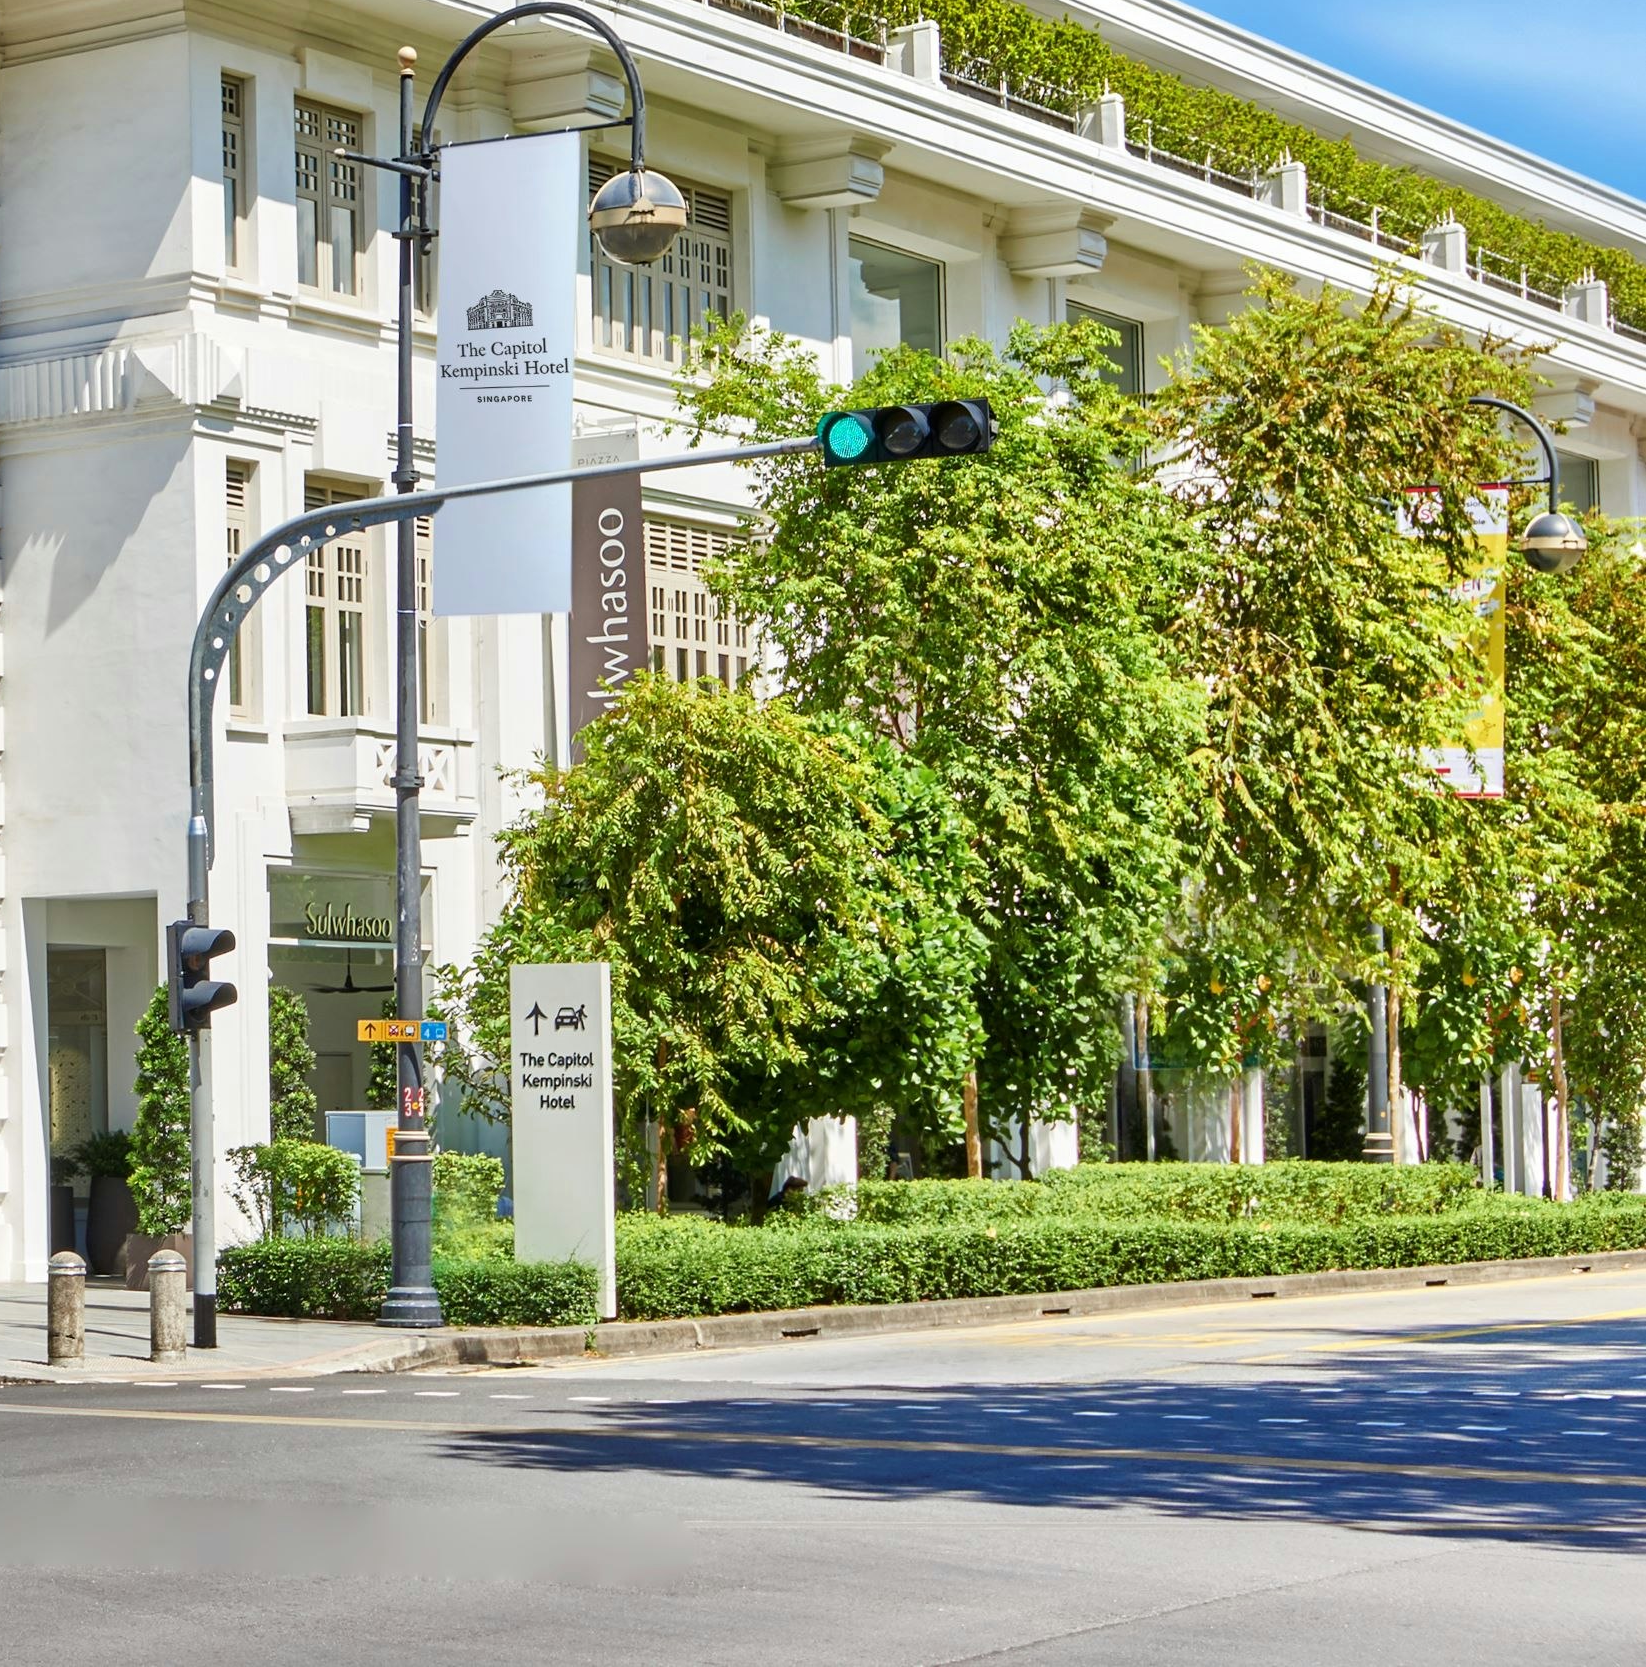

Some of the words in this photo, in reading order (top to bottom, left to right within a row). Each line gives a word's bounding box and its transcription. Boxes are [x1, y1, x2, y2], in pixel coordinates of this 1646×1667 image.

[457, 342, 486, 358] The
[491, 338, 548, 360] Capitol
[440, 361, 520, 382] Kempinski
[524, 358, 570, 376] Hotel
[477, 394, 533, 403] SINGAPORE
[585, 507, 630, 710] lwhasoo
[305, 901, 393, 938] Sulwhasoo
[520, 1052, 545, 1067] The
[548, 1052, 594, 1070] Capitol
[522, 1073, 593, 1092] Kempinski
[540, 1094, 576, 1109] Hotel
